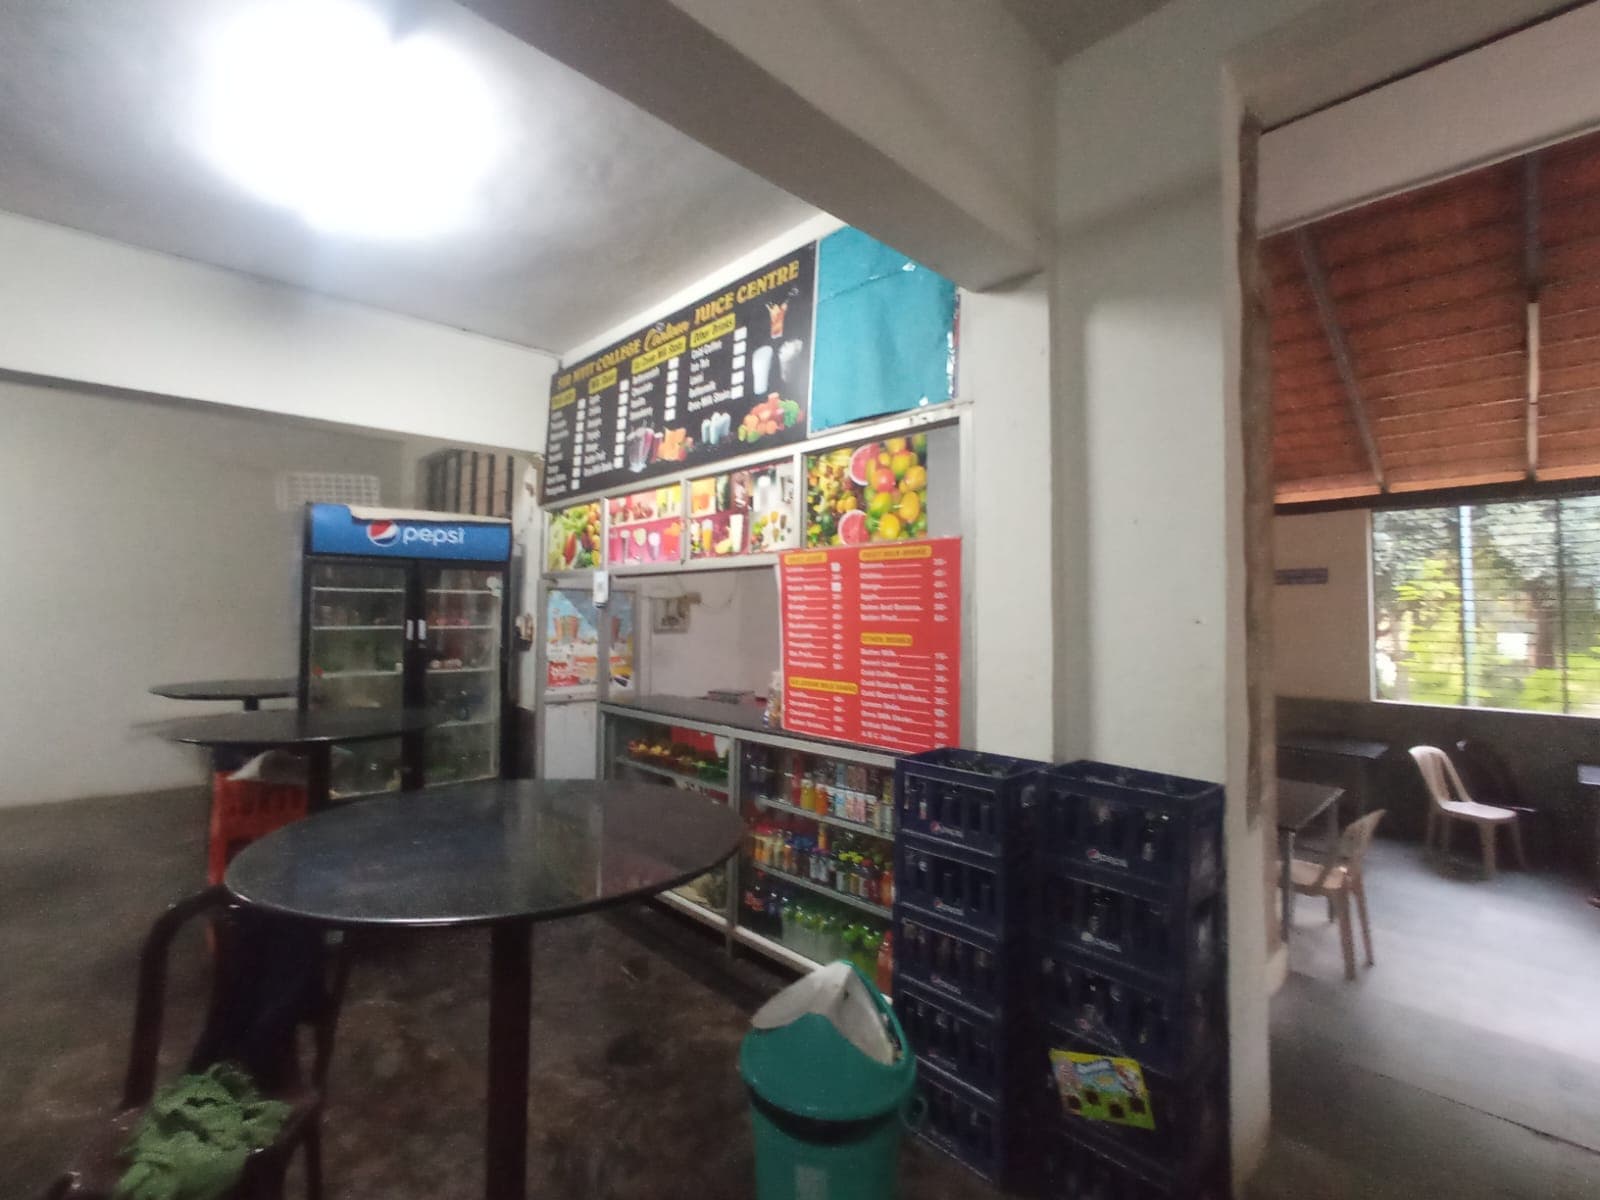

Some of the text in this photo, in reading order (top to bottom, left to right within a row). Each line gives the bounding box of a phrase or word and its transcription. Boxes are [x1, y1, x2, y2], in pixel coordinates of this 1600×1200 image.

[694, 293, 734, 324] JUICE
[737, 261, 799, 304] CENTRE
[402, 526, 465, 546] pepsi
